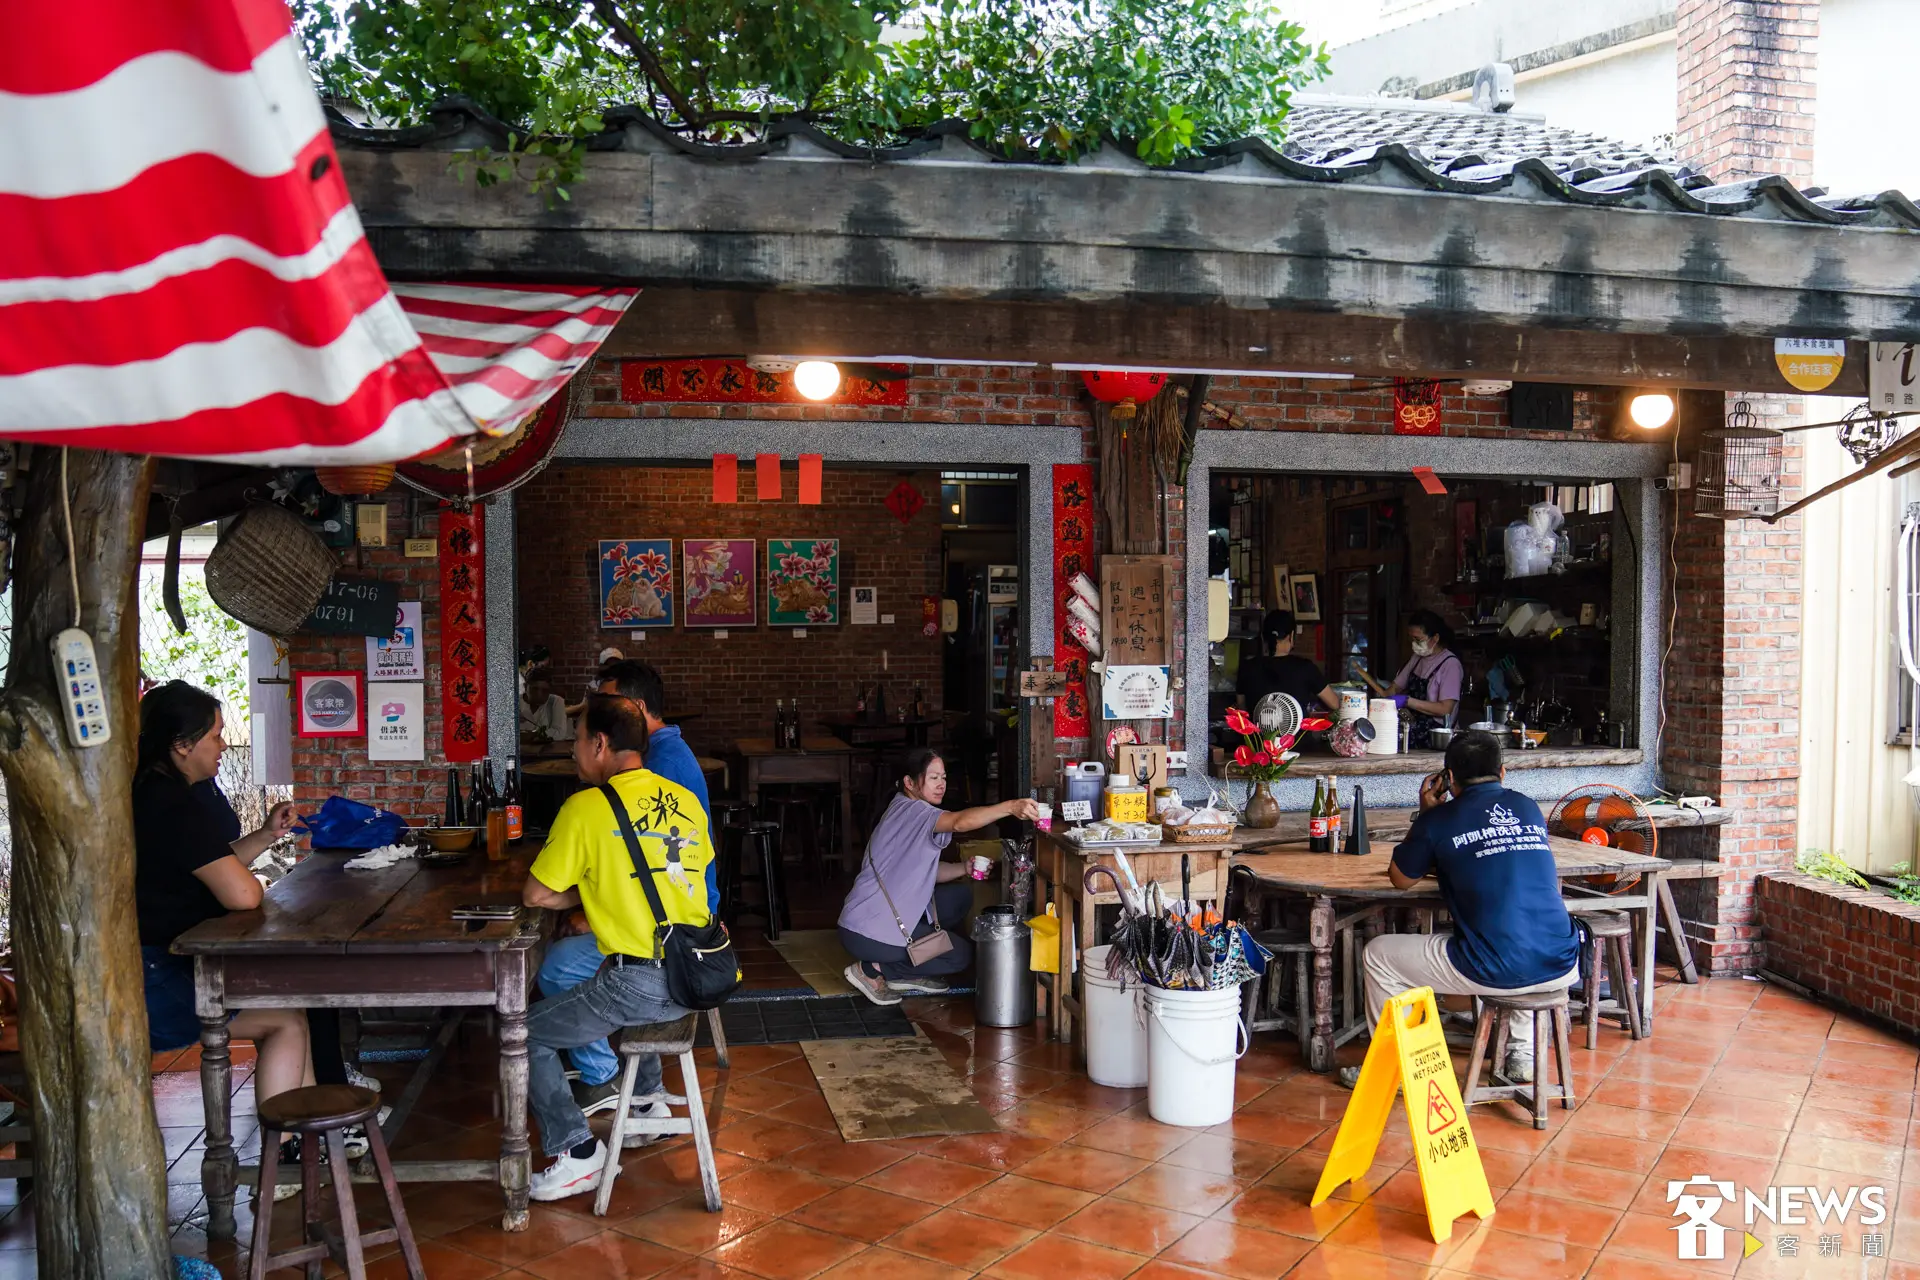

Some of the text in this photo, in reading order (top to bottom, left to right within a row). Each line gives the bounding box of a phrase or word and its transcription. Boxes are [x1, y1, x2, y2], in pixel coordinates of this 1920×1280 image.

[1788, 362, 1833, 376] 合作店家
[1150, 579, 1162, 603] 平日
[315, 605, 355, 622] 0791
[1129, 585, 1147, 652] 週三休息
[1023, 674, 1060, 693] 奉茶
[314, 698, 345, 709] 客家幣
[1414, 1049, 1441, 1067] CAUTION
[1412, 1060, 1448, 1081] WET FLOOR
[1428, 1126, 1470, 1164] 小心地滑
